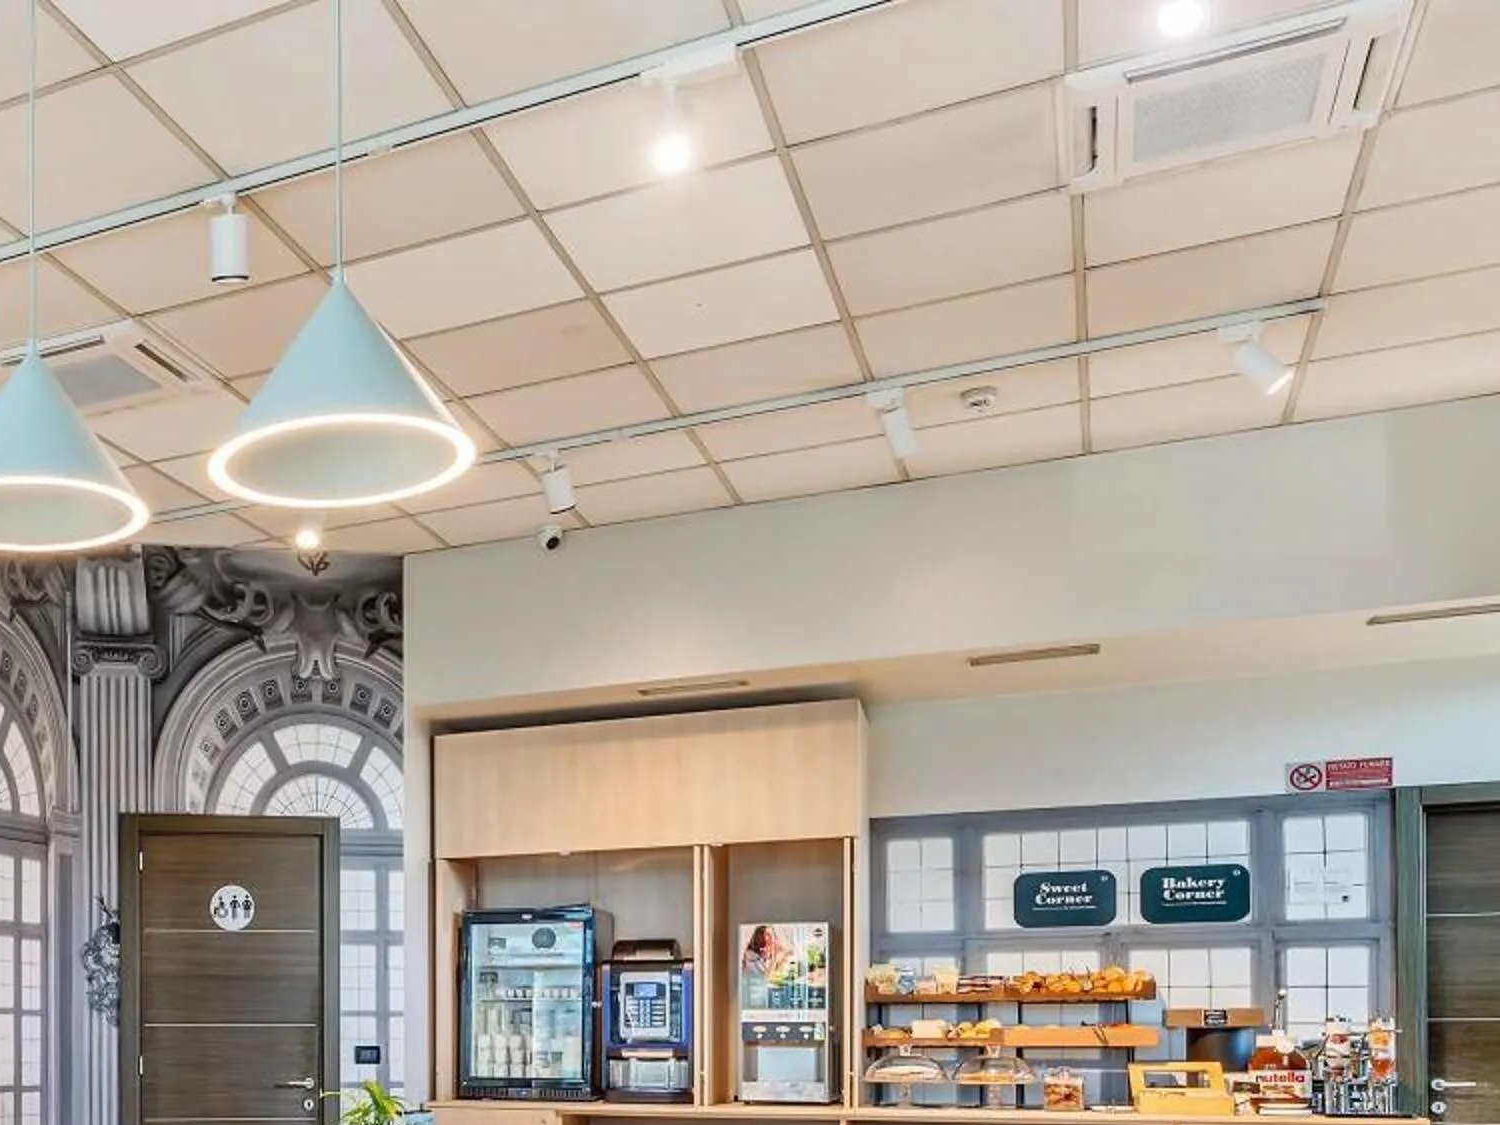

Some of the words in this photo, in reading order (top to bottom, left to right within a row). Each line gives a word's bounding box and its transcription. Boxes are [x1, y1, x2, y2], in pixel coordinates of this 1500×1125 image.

[1040, 881, 1088, 893] Sweet
[1162, 877, 1225, 889] Bakery
[1035, 893, 1093, 905] Corner
[1163, 890, 1225, 901] Corner
[1255, 1072, 1305, 1083] nutella
